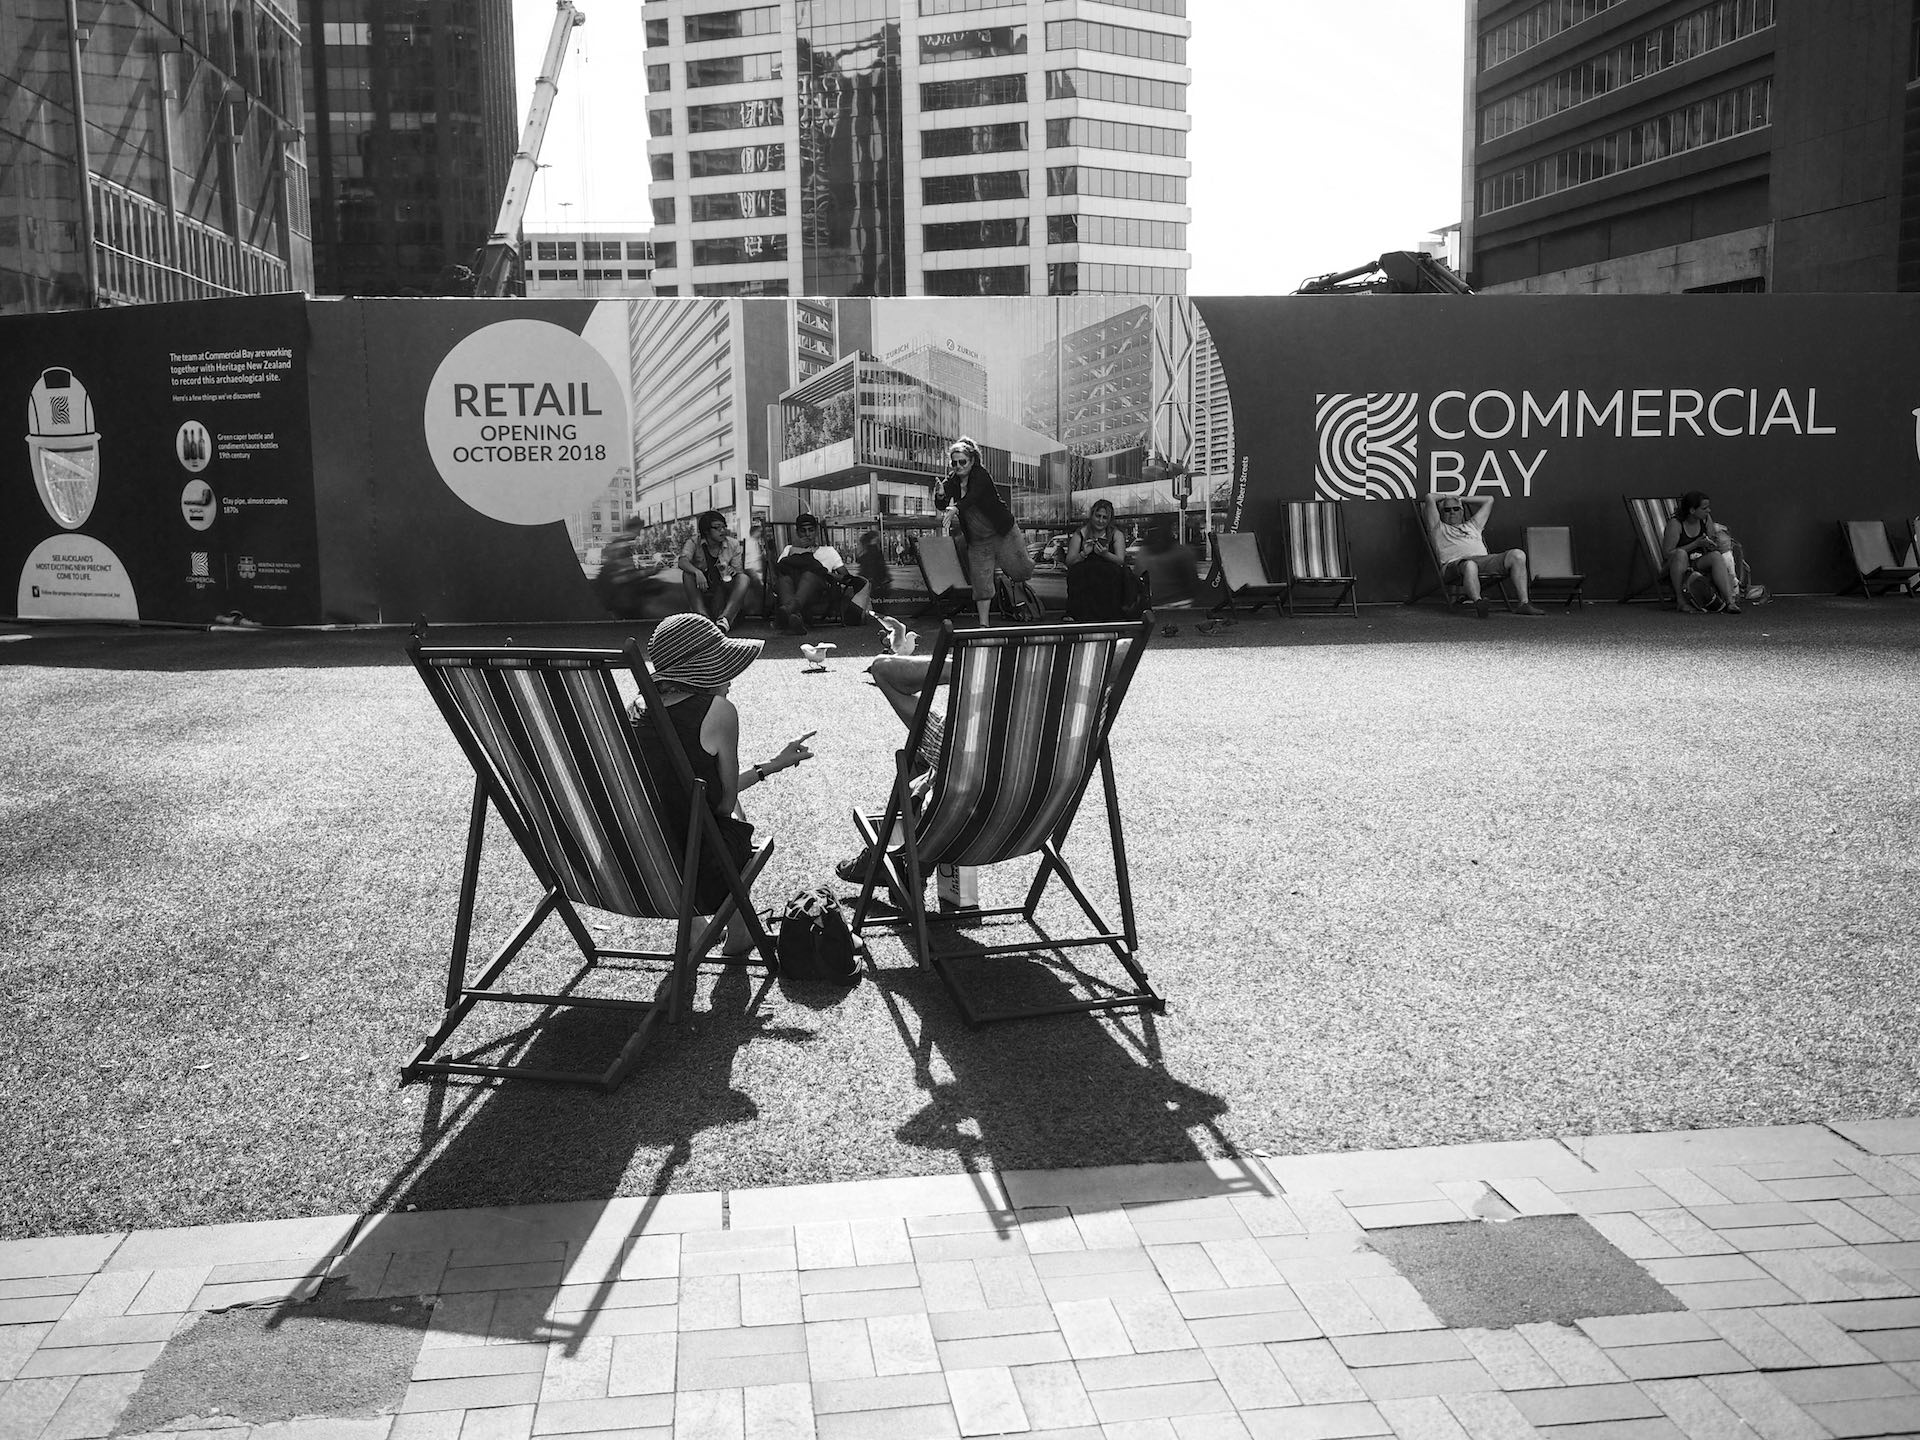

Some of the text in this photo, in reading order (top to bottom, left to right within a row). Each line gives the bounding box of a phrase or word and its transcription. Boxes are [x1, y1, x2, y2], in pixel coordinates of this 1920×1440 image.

[170, 353, 181, 362] The
[182, 353, 198, 361] team
[198, 352, 205, 360] at
[205, 350, 241, 360] Commercial
[242, 349, 254, 359] Bay
[265, 348, 292, 358] working
[886, 343, 909, 360] ZURICH
[957, 344, 979, 359] ZURICH
[170, 360, 291, 375] together with Heritage New Zealand
[180, 376, 201, 385] record
[202, 375, 215, 384] this
[216, 373, 264, 384] archaeological
[265, 372, 281, 382] site.
[202, 393, 218, 401] things
[454, 382, 602, 417] RETAIL
[1428, 387, 1837, 440] COMMERCIAL
[480, 424, 577, 441] OPENING
[453, 444, 606, 462] OCTOBER 2018
[1240, 455, 1249, 483] Streets
[1430, 449, 1548, 497] BAY
[1237, 482, 1246, 506] Albert
[1232, 507, 1242, 531] Lower
